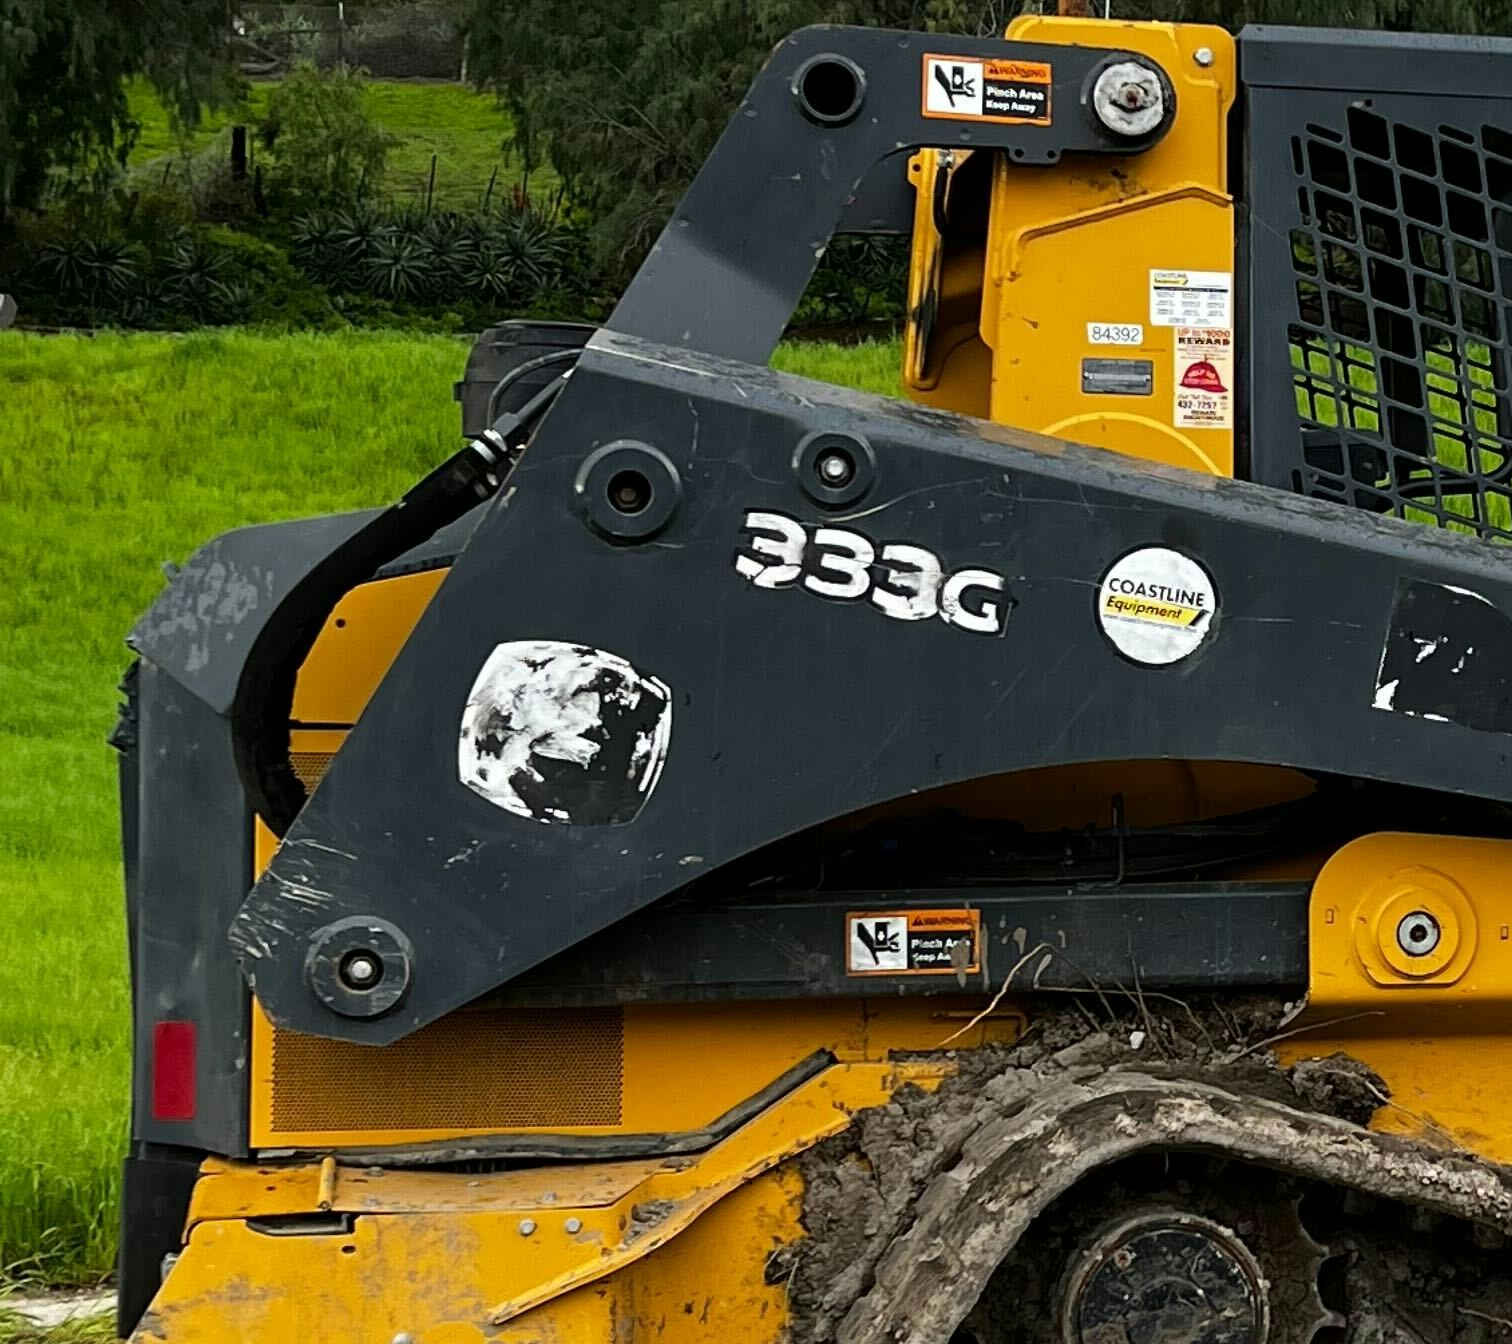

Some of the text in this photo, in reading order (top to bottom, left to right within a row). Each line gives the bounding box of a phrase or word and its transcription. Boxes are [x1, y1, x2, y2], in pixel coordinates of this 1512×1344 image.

[986, 86, 1044, 101] Pinch Area
[986, 100, 1036, 114] Keep Away
[1091, 326, 1140, 342] 84392
[735, 511, 1005, 633] 333G
[1109, 577, 1205, 607] COASTLINE
[1106, 595, 1182, 619] Equipment
[911, 939, 943, 949] Pinch
